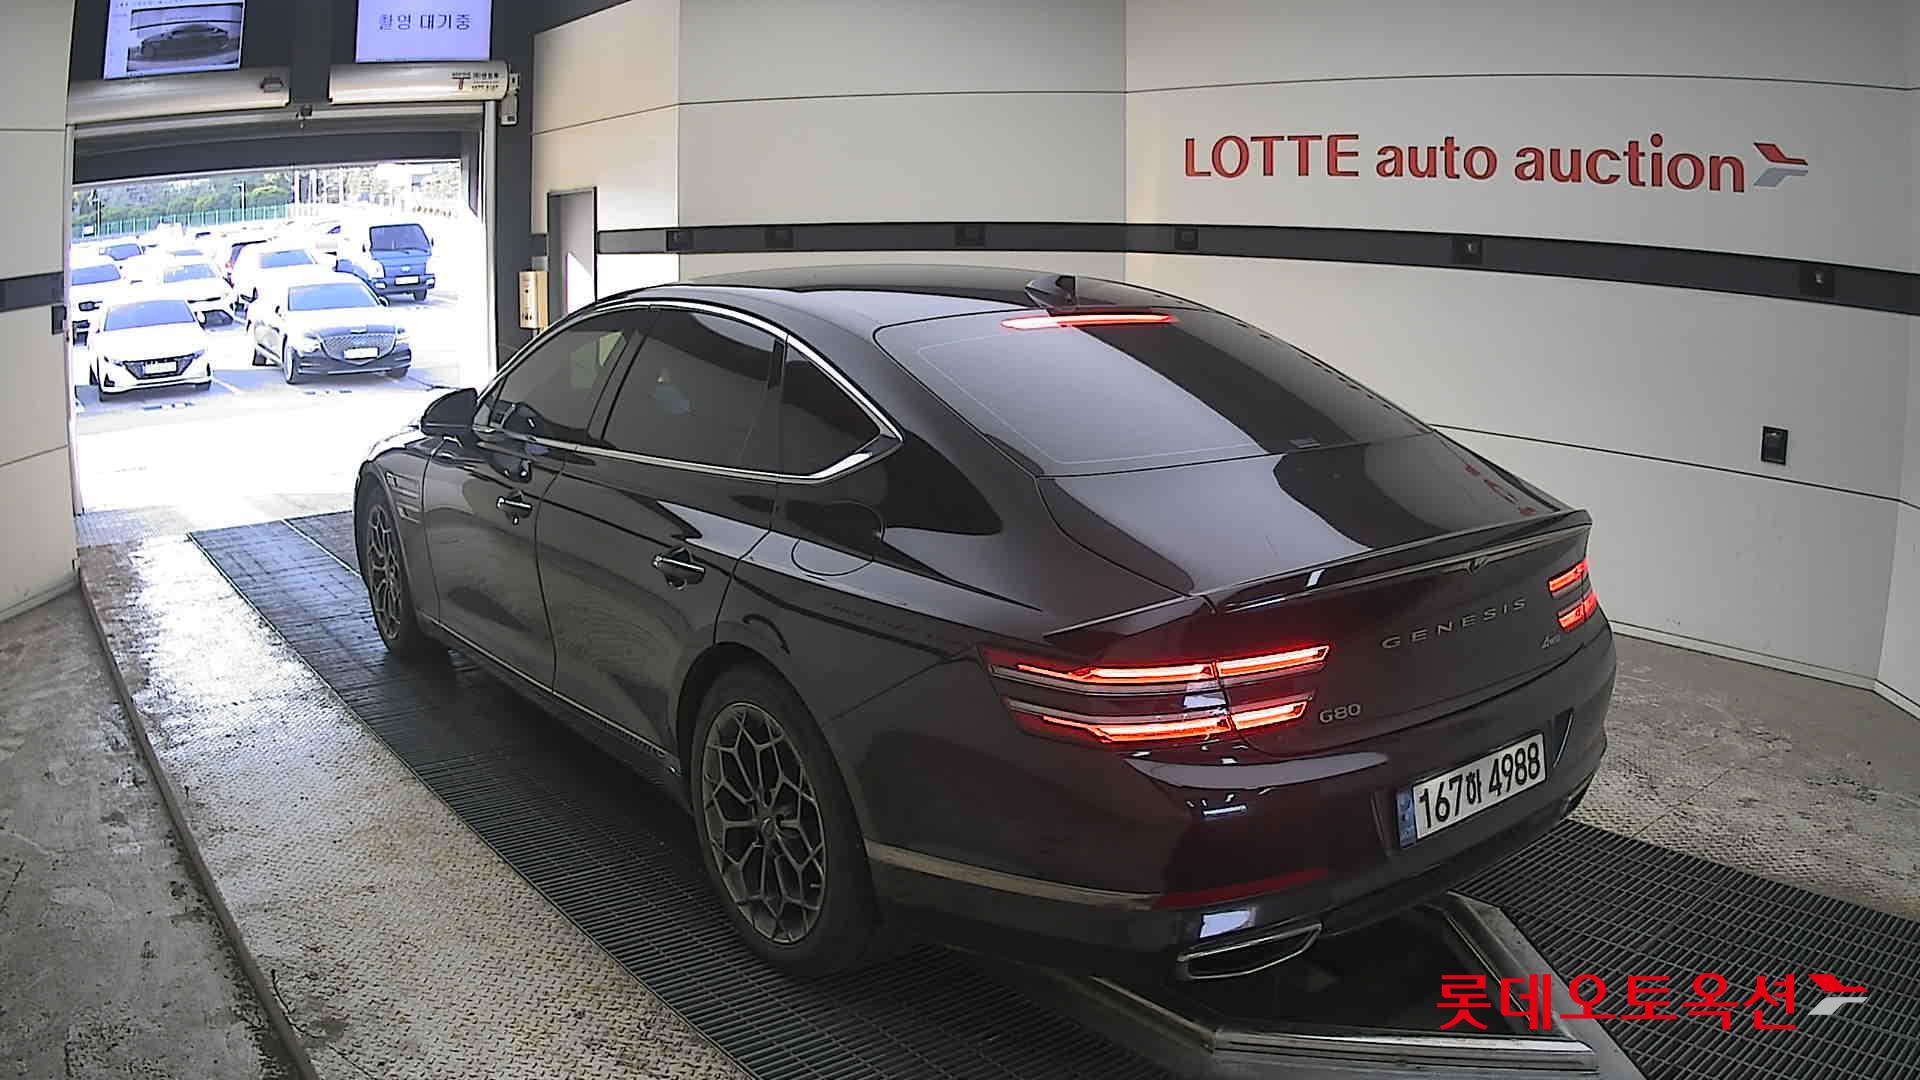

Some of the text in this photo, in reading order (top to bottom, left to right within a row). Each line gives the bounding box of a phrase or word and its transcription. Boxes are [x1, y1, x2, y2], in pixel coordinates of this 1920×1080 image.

[419, 14, 472, 31] 대기중
[1184, 133, 1745, 193] LOTTE auto auction
[1381, 598, 1527, 650] GENESIS
[1319, 703, 1362, 724] G80
[1418, 742, 1541, 829] 167하 4988
